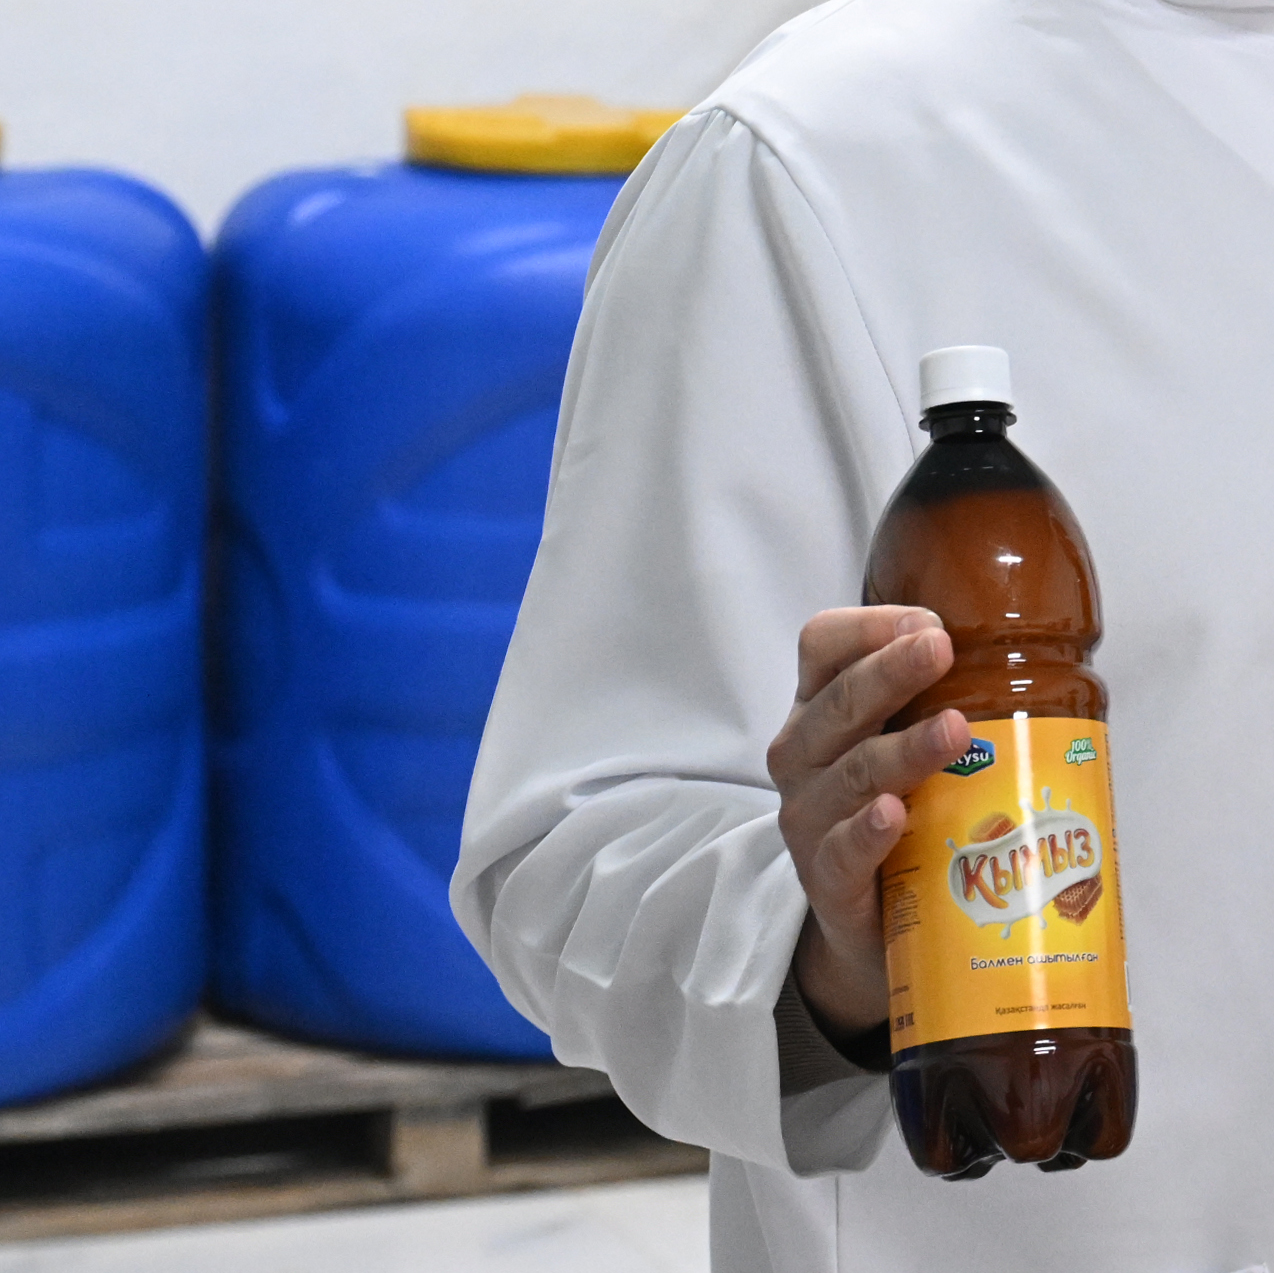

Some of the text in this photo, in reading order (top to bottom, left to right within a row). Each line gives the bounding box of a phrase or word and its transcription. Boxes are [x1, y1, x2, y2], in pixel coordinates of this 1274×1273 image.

[1066, 749, 1097, 766] Organic
[971, 951, 1099, 971] Балмен ашытылған
